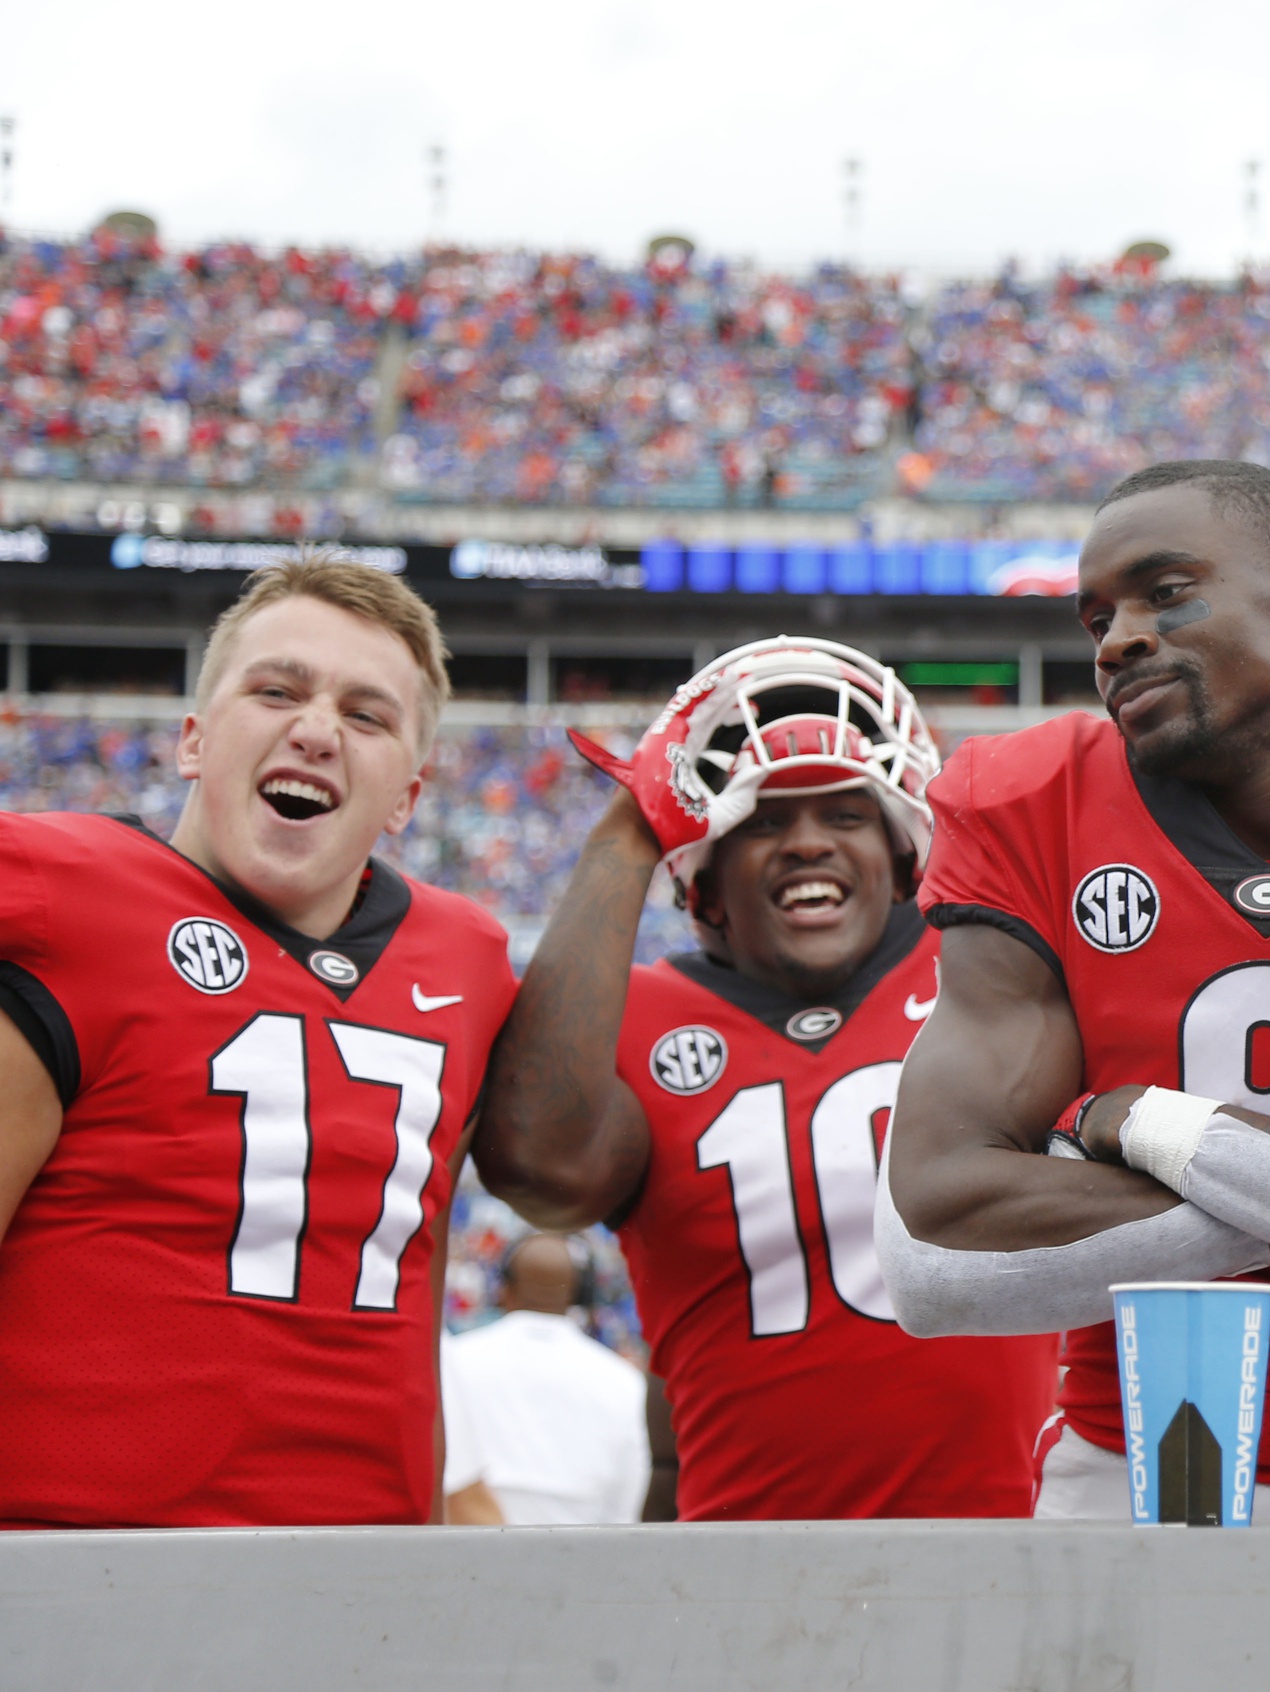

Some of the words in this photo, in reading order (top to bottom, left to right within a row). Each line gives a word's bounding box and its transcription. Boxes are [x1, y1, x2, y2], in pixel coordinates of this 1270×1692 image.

[1079, 870, 1151, 946] SEC
[174, 921, 242, 988] SEC
[310, 950, 359, 984] G
[655, 1029, 721, 1090] SEC
[786, 1007, 842, 1040] G
[207, 1009, 448, 1313] 17
[696, 1060, 906, 1340] 10
[1121, 1305, 1149, 1519] POWERADE
[1232, 1306, 1262, 1520] POWERADE
